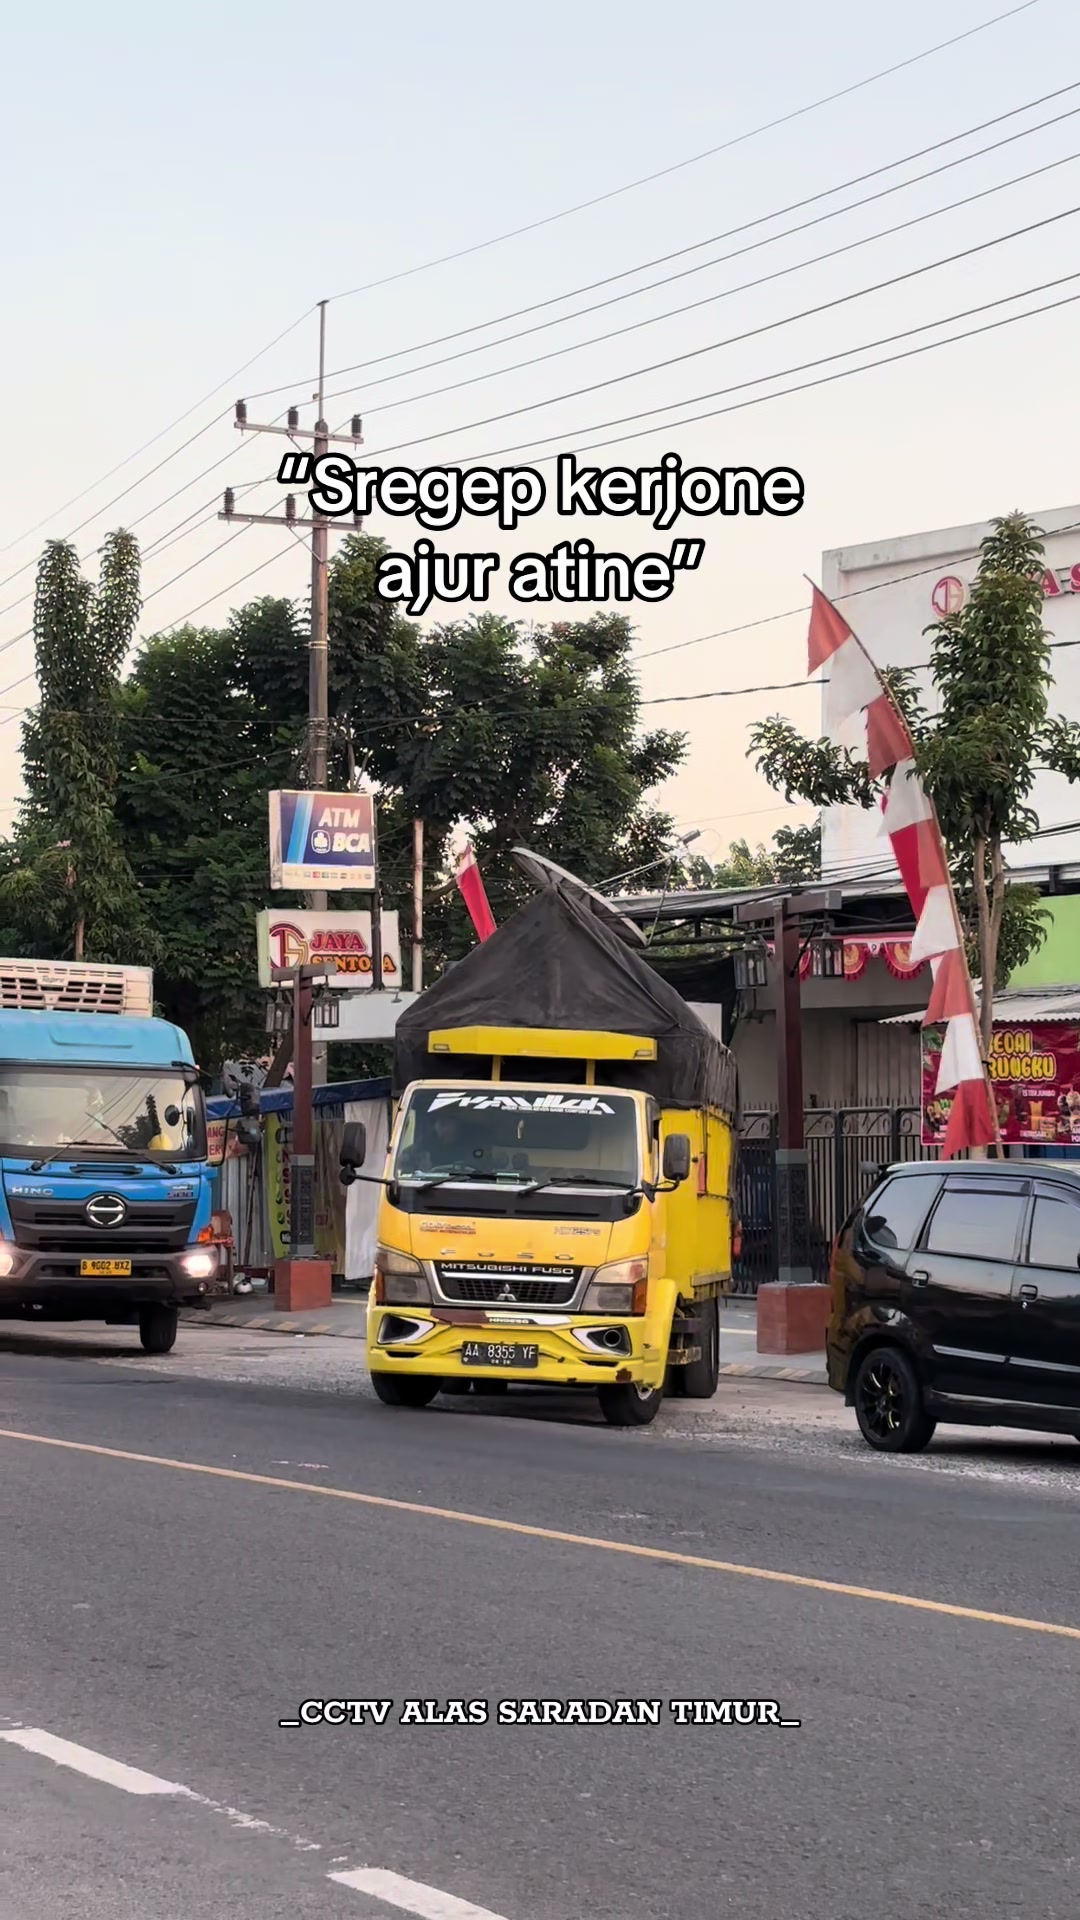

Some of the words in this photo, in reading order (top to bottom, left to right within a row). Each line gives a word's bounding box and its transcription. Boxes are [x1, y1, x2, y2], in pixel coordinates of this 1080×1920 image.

[318, 807, 360, 828] ATM
[332, 832, 370, 853] BCA
[311, 931, 365, 951] JAYA
[311, 954, 397, 973] SNTOA
[989, 1030, 1031, 1054] EDAI
[989, 1054, 1055, 1079] RUNGKU
[11, 1187, 54, 1196] HINO
[440, 1262, 528, 1273] MITSUBISHI
[532, 1266, 574, 1275] FUSO
[465, 1343, 479, 1357] AA
[487, 1344, 515, 1359] 8355
[522, 1346, 536, 1359] YF
